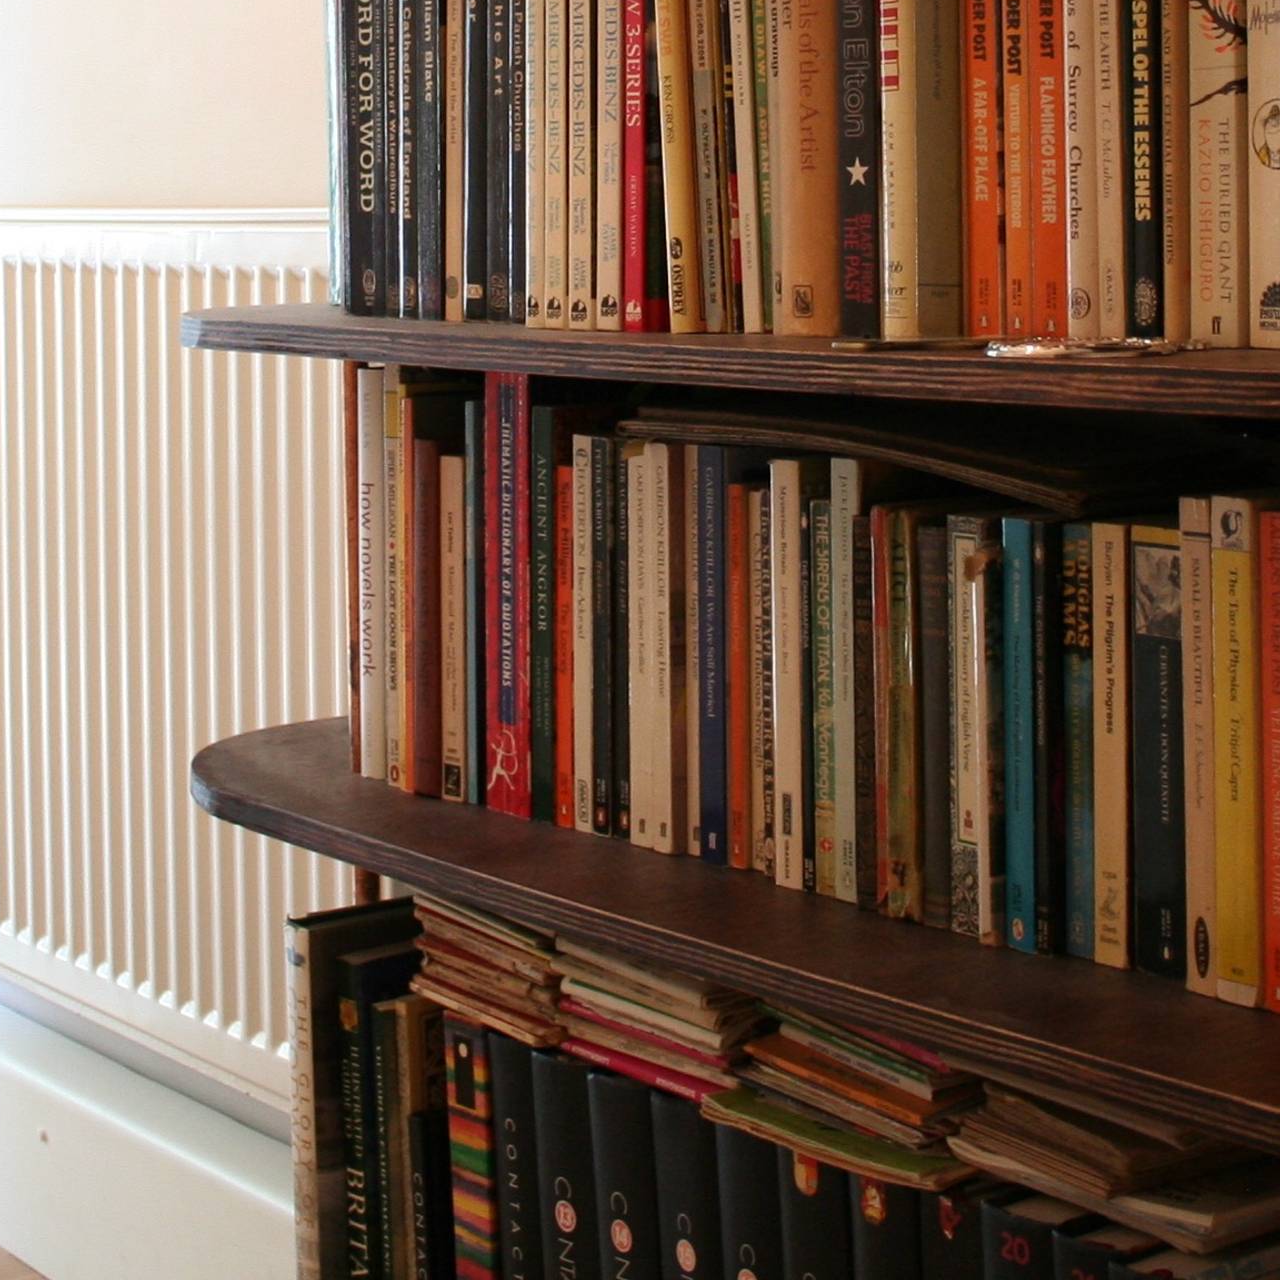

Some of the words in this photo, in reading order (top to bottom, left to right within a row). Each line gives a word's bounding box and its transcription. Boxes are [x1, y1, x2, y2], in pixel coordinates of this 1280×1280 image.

[800, 34, 818, 57] of
[973, 26, 987, 61] POST
[1040, 21, 1054, 59] POST
[1066, 30, 1081, 50] of
[1133, 54, 1148, 81] OF
[359, 54, 374, 112] FOR
[626, 23, 641, 128] 3-SERIES
[801, 61, 818, 100] the
[844, 39, 868, 137] Elton
[974, 77, 987, 88] A
[1067, 65, 1081, 132] Surrey
[1040, 77, 1054, 155] FLAMINGO
[1134, 85, 1149, 125] THE
[801, 103, 820, 173] Artist
[1198, 118, 1212, 193] KAZUO
[1218, 118, 1231, 155] THE
[360, 118, 375, 212] WORD
[975, 156, 988, 202] PLACE
[1042, 160, 1056, 224] FEATHER
[1069, 145, 1083, 239] Churches
[1135, 131, 1150, 221] ESSENES
[1218, 163, 1232, 239] BURIED
[1199, 200, 1213, 302] ISHIGURO
[1219, 245, 1232, 303] GIANT
[671, 264, 687, 315] OSPREY
[360, 482, 375, 530] how
[537, 455, 546, 540] ANCIENT
[502, 494, 512, 575] DICTIONARY
[816, 514, 828, 546] THE
[361, 538, 376, 611] novels
[502, 580, 512, 597] OF
[537, 549, 547, 631] ANGKOR
[816, 549, 829, 602] SIRENS
[1228, 569, 1240, 596] The
[817, 606, 830, 630] OF
[1105, 594, 1115, 616] The
[362, 619, 377, 677] work
[502, 602, 512, 687] QUOTATIONS
[1104, 620, 1116, 674] Pilgrim's
[1229, 629, 1241, 643] of
[1227, 648, 1241, 702] Physics
[1104, 678, 1116, 734] Progress
